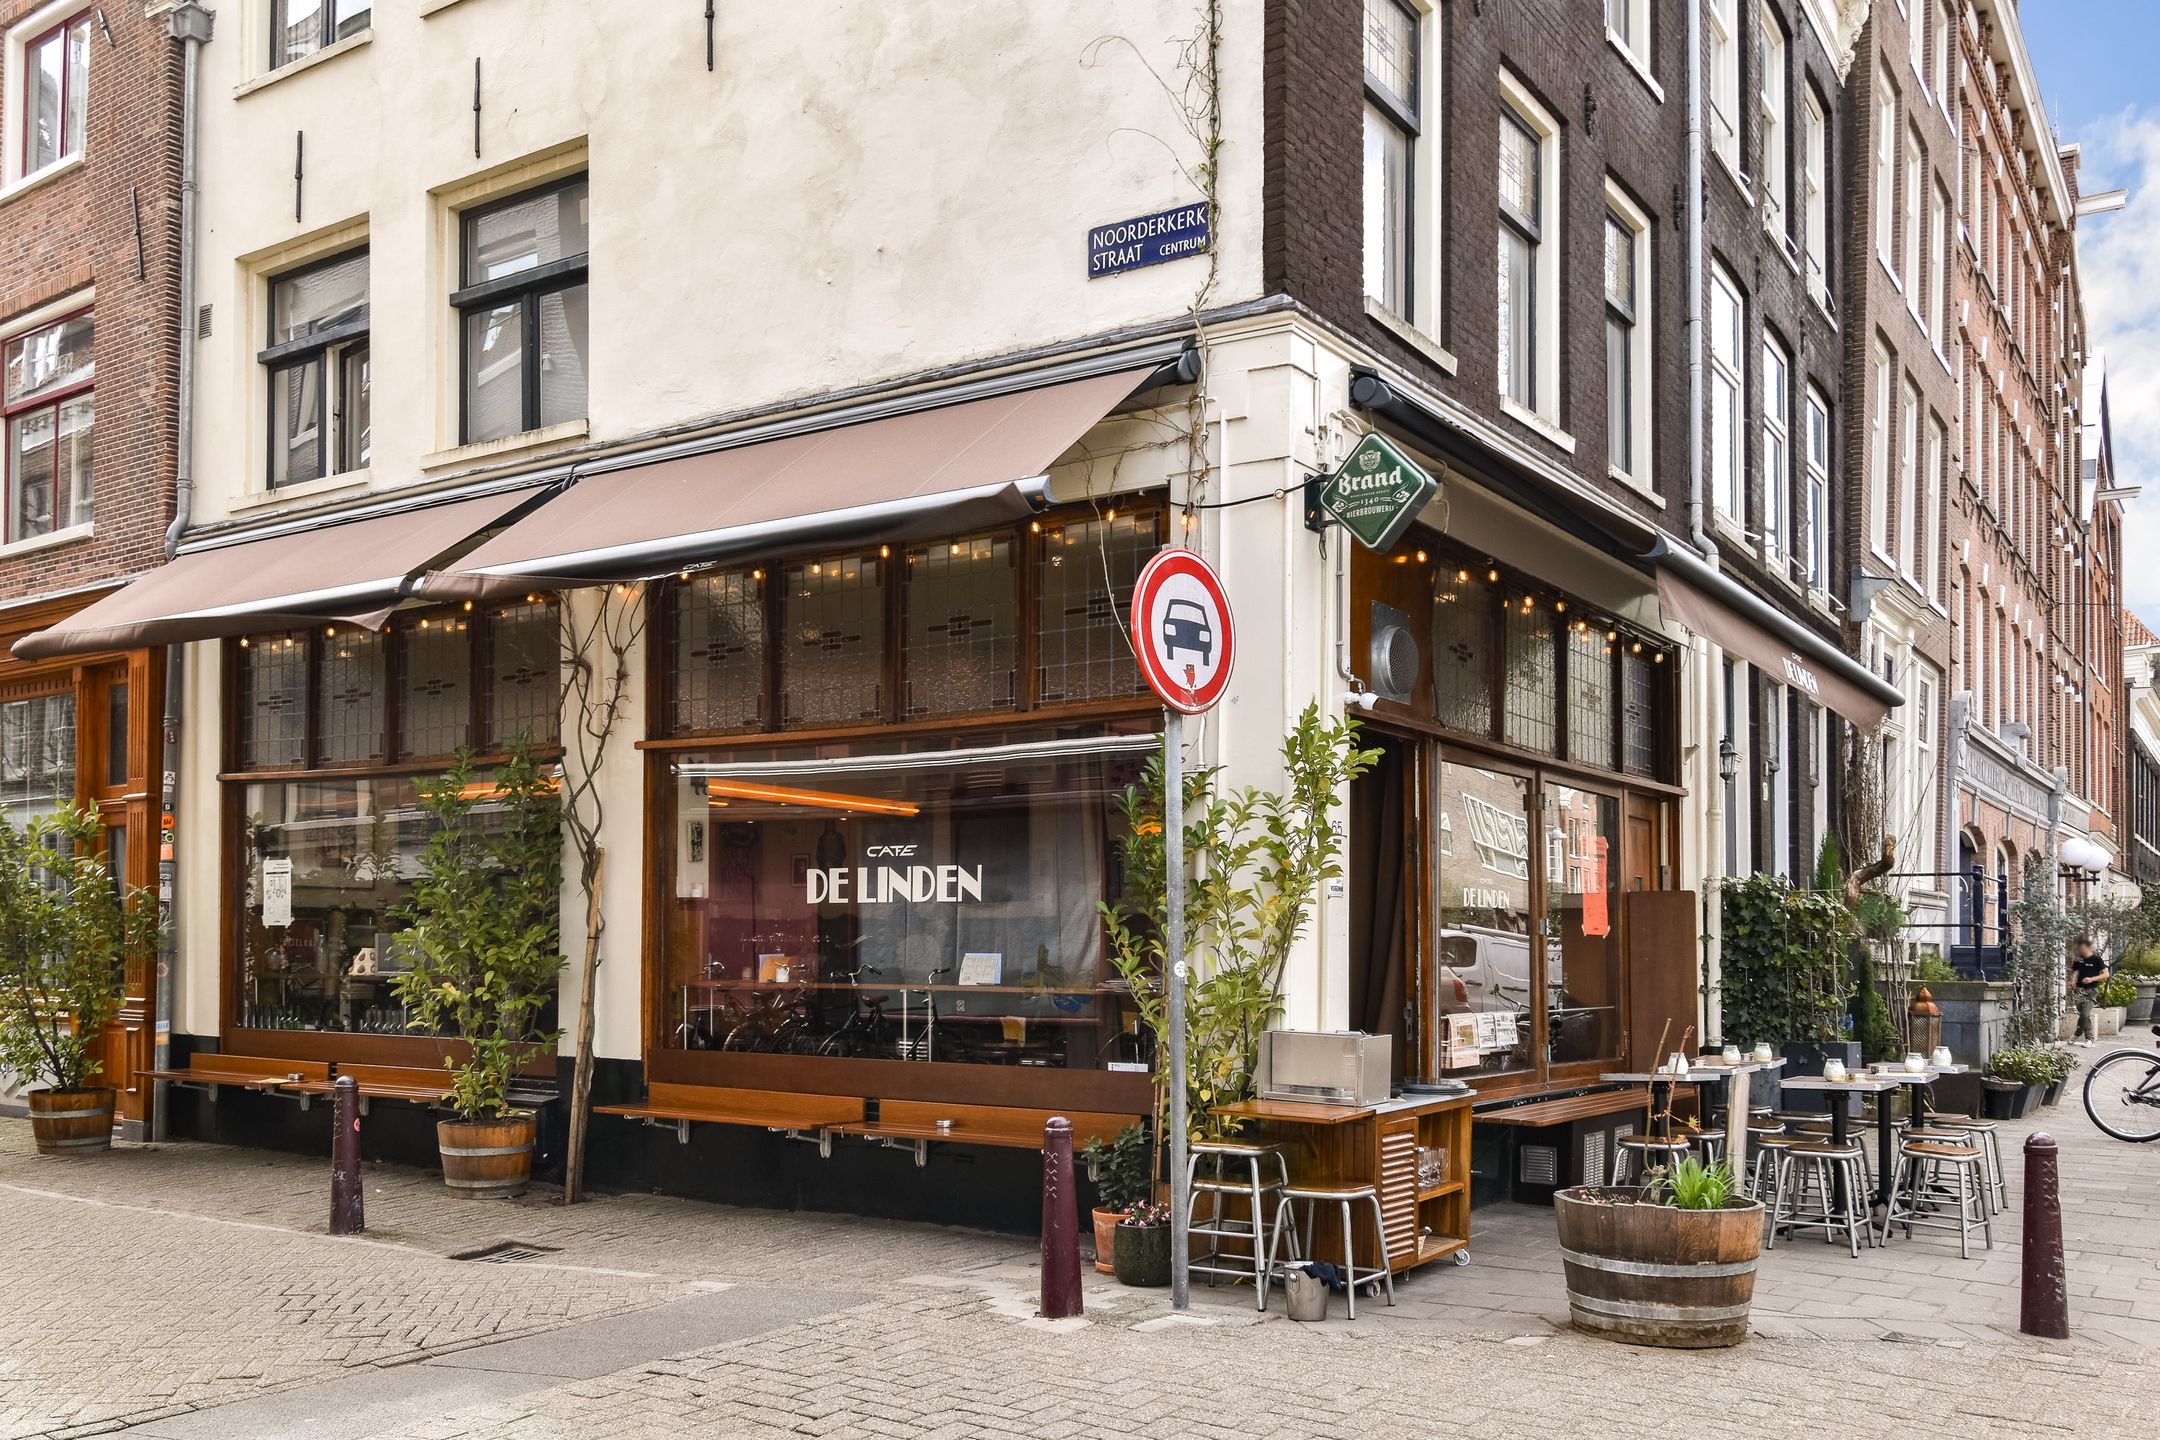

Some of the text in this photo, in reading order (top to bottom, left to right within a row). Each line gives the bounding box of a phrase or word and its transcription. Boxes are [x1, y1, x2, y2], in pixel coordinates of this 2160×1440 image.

[1093, 206, 1206, 249] NOORDERKERK
[1093, 235, 1206, 271] STRAAT CENTRUM
[1338, 465, 1403, 496] Brand
[1346, 505, 1395, 518] BIERBROUWERIJ
[1360, 496, 1379, 506] 1340
[806, 864, 982, 904] DE LINDEN
[1463, 887, 1510, 908] DE LINDEN
